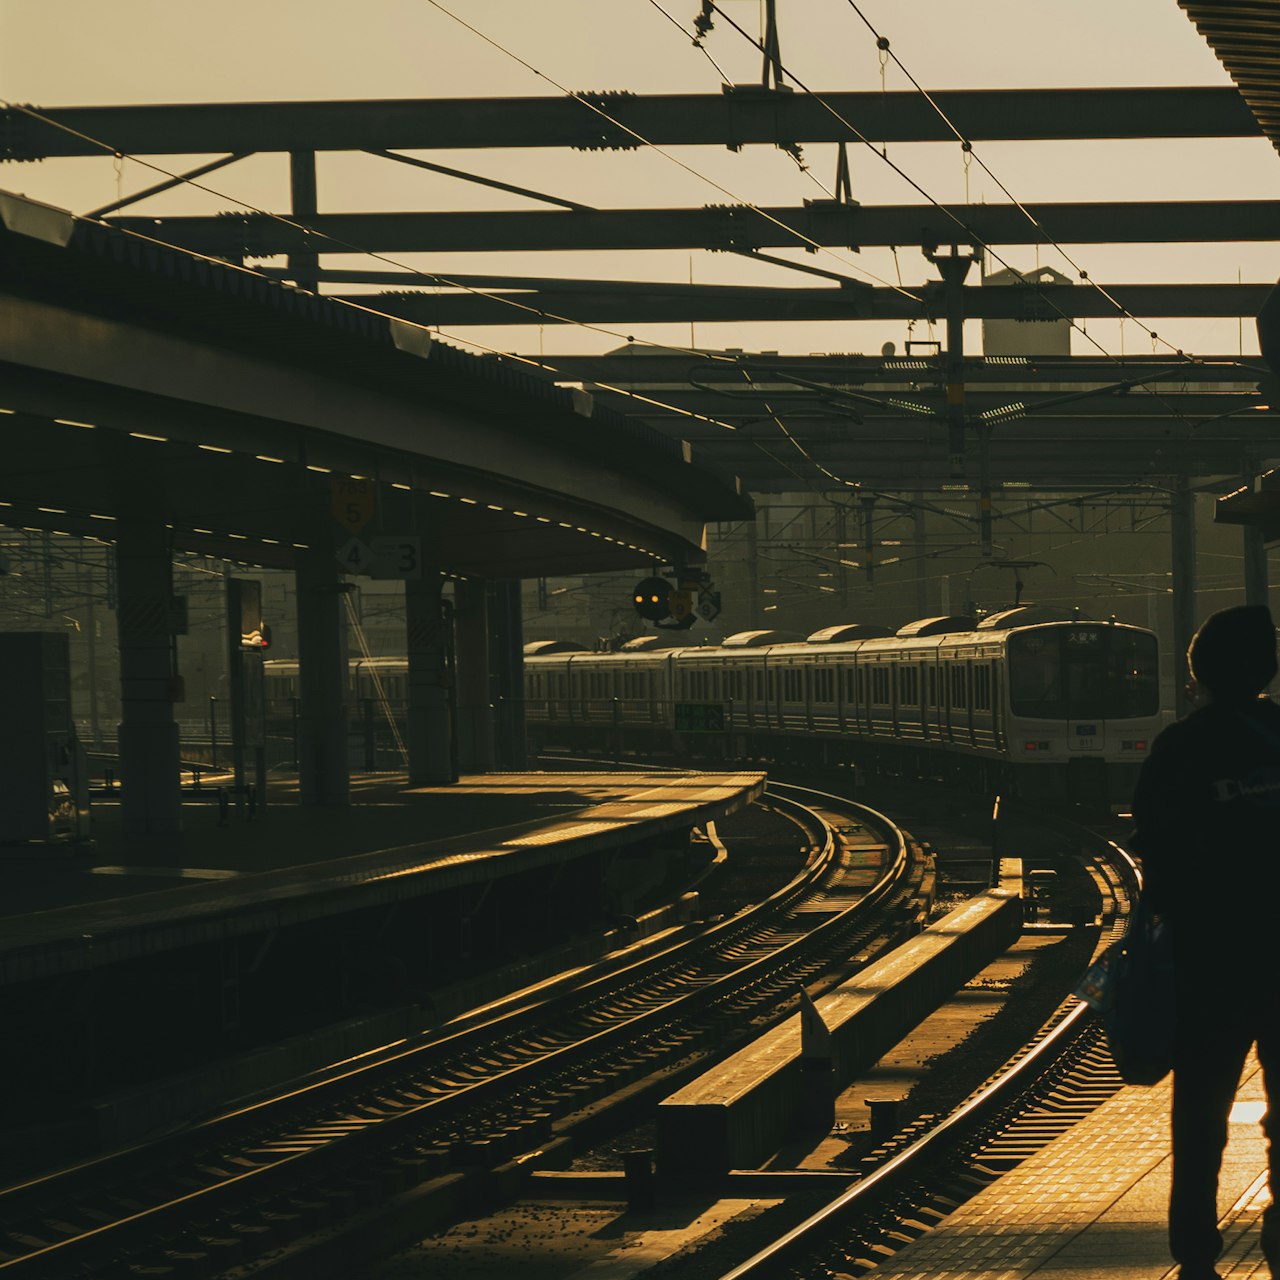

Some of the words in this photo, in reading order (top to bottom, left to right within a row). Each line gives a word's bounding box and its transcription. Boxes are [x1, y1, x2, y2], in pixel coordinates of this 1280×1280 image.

[346, 503, 361, 524] 5
[347, 546, 361, 567] 4
[397, 544, 417, 572] 3
